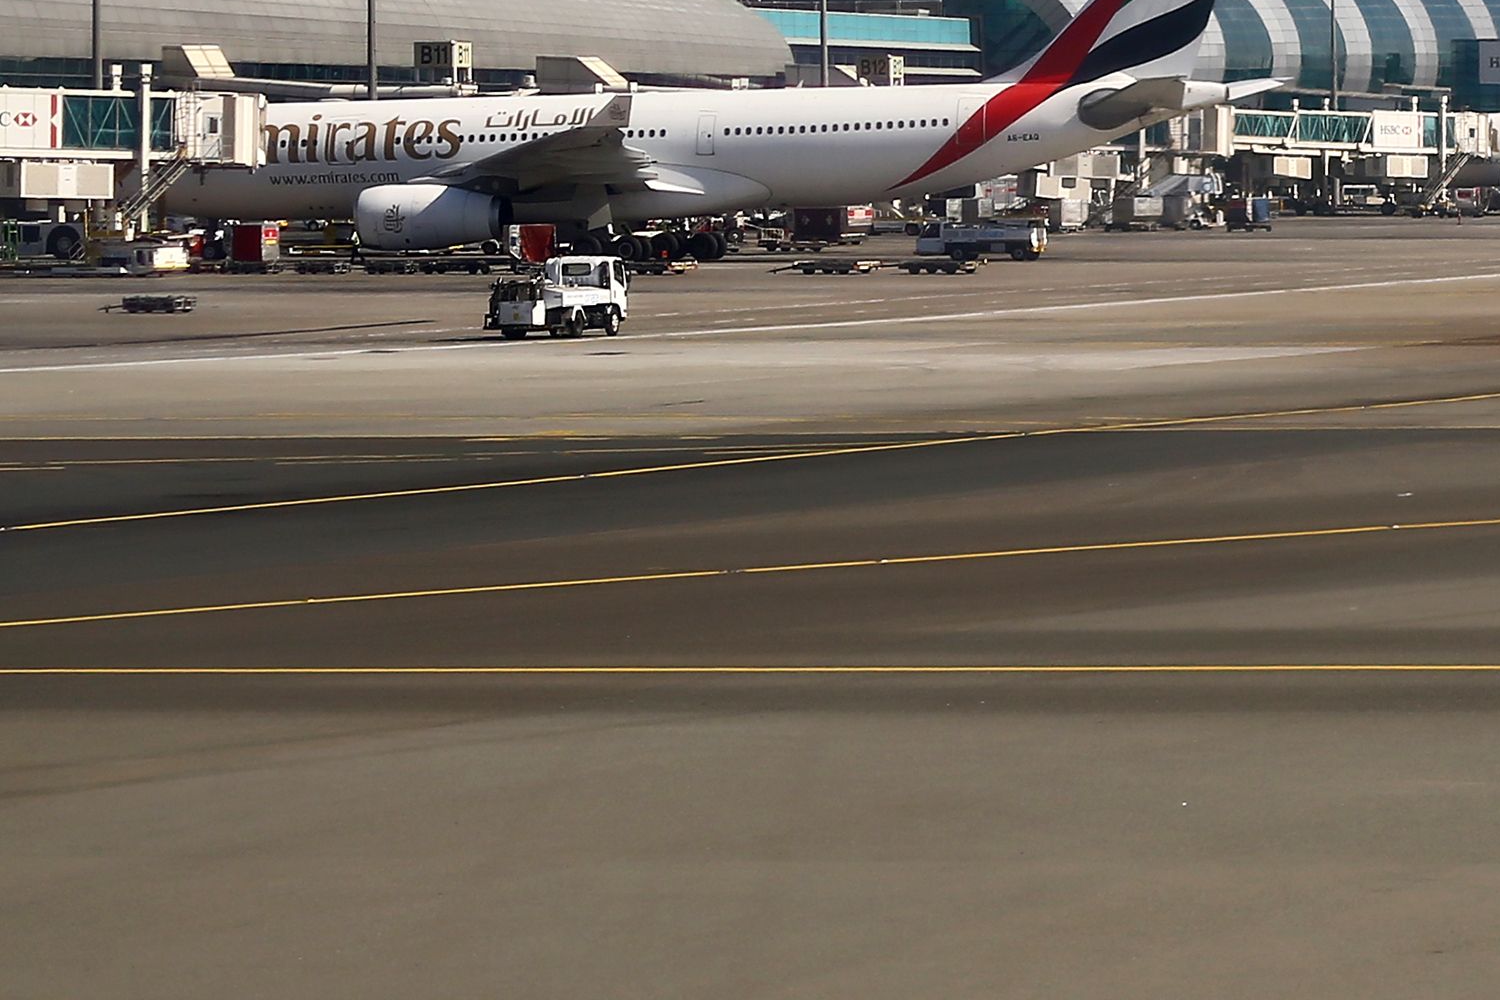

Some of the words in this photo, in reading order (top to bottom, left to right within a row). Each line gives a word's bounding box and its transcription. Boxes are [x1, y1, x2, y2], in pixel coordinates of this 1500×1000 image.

[421, 45, 448, 64] B11
[861, 60, 886, 75] B12
[264, 114, 461, 164] mirates
[269, 171, 400, 185] www.emirates.com
